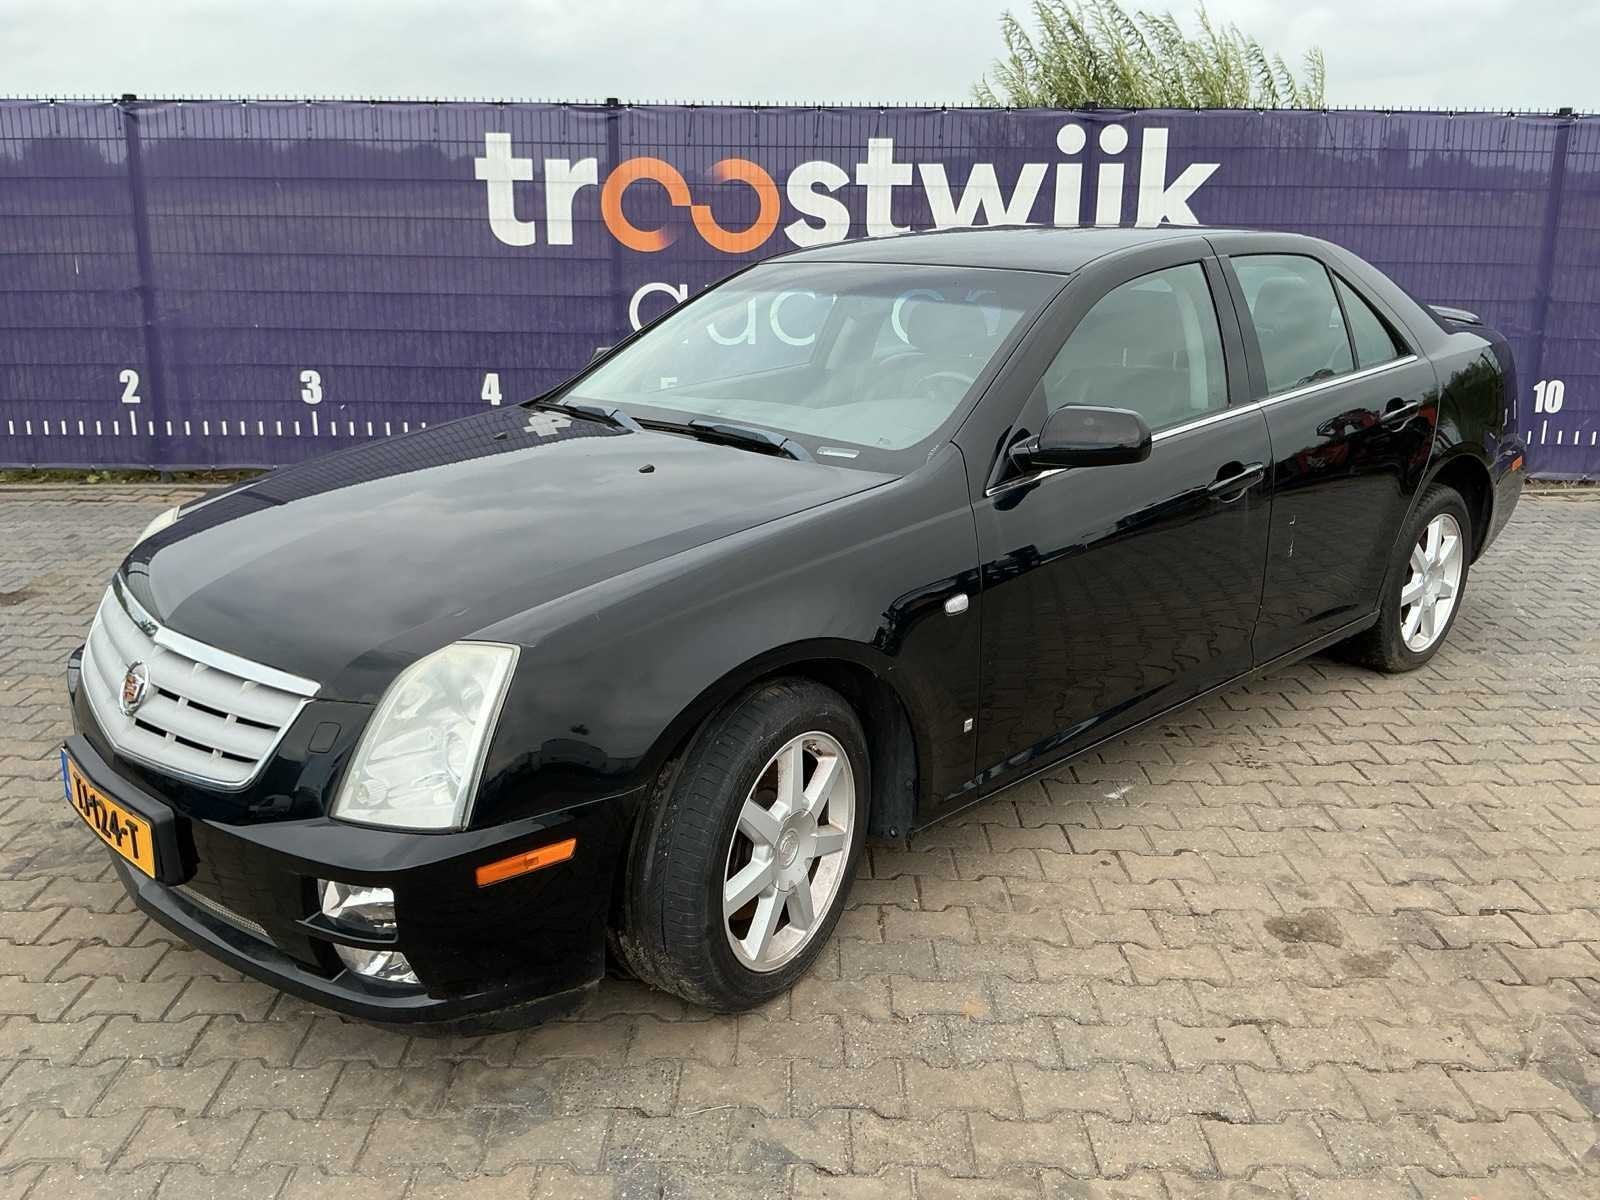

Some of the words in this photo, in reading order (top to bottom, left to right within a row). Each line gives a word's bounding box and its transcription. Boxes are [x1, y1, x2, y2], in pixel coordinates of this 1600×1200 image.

[120, 370, 141, 403] 2
[301, 370, 323, 404] 3
[481, 373, 502, 405] 4
[1534, 380, 1565, 413] 10
